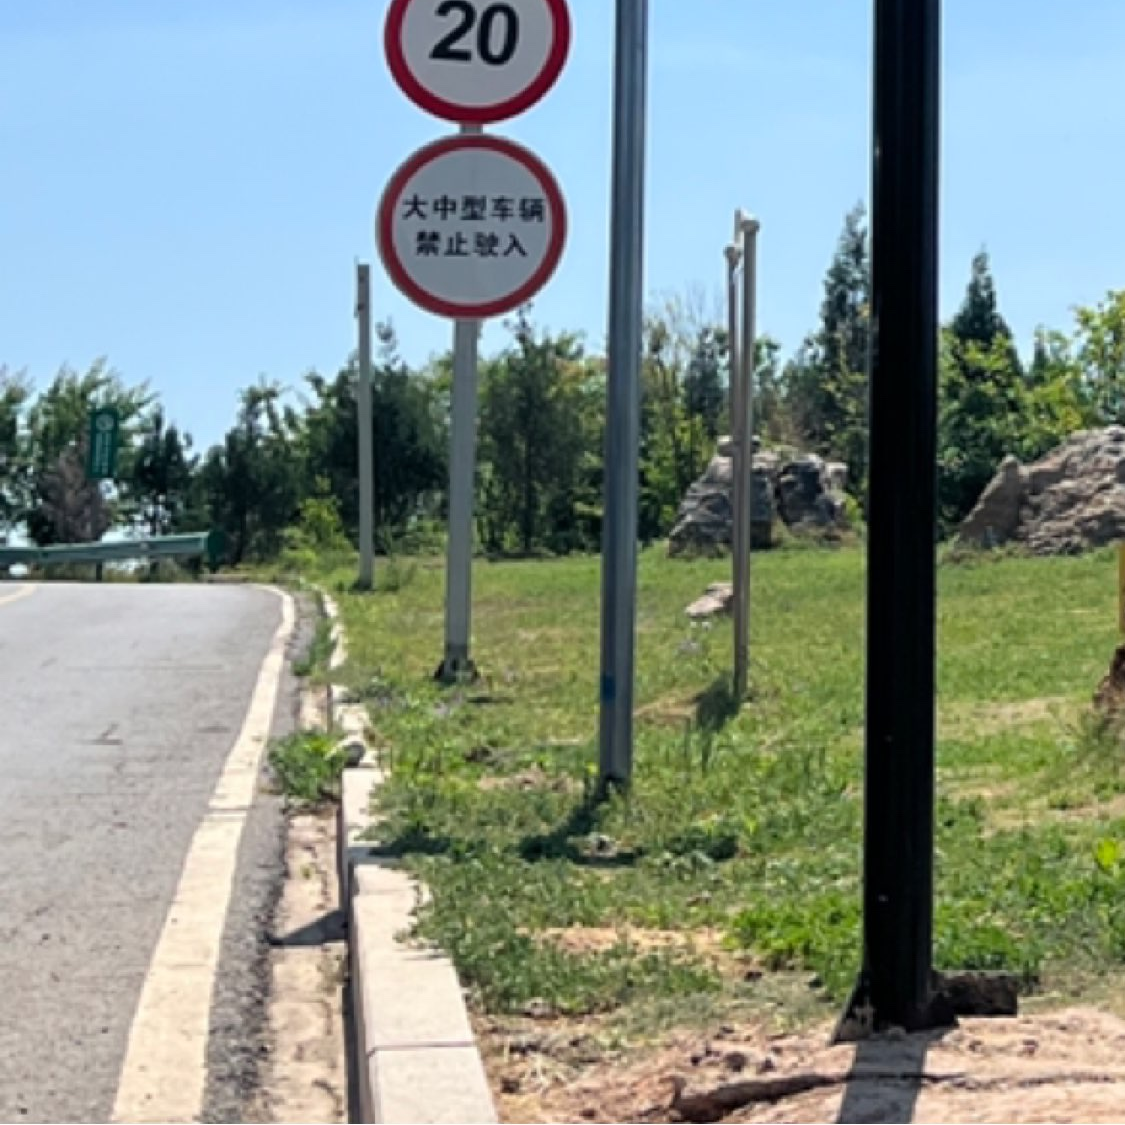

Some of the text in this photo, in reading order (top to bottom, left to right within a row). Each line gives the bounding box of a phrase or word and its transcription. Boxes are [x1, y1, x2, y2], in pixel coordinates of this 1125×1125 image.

[402, 193, 545, 222] 大中型车辆
[416, 230, 528, 257] 禁止驶入
